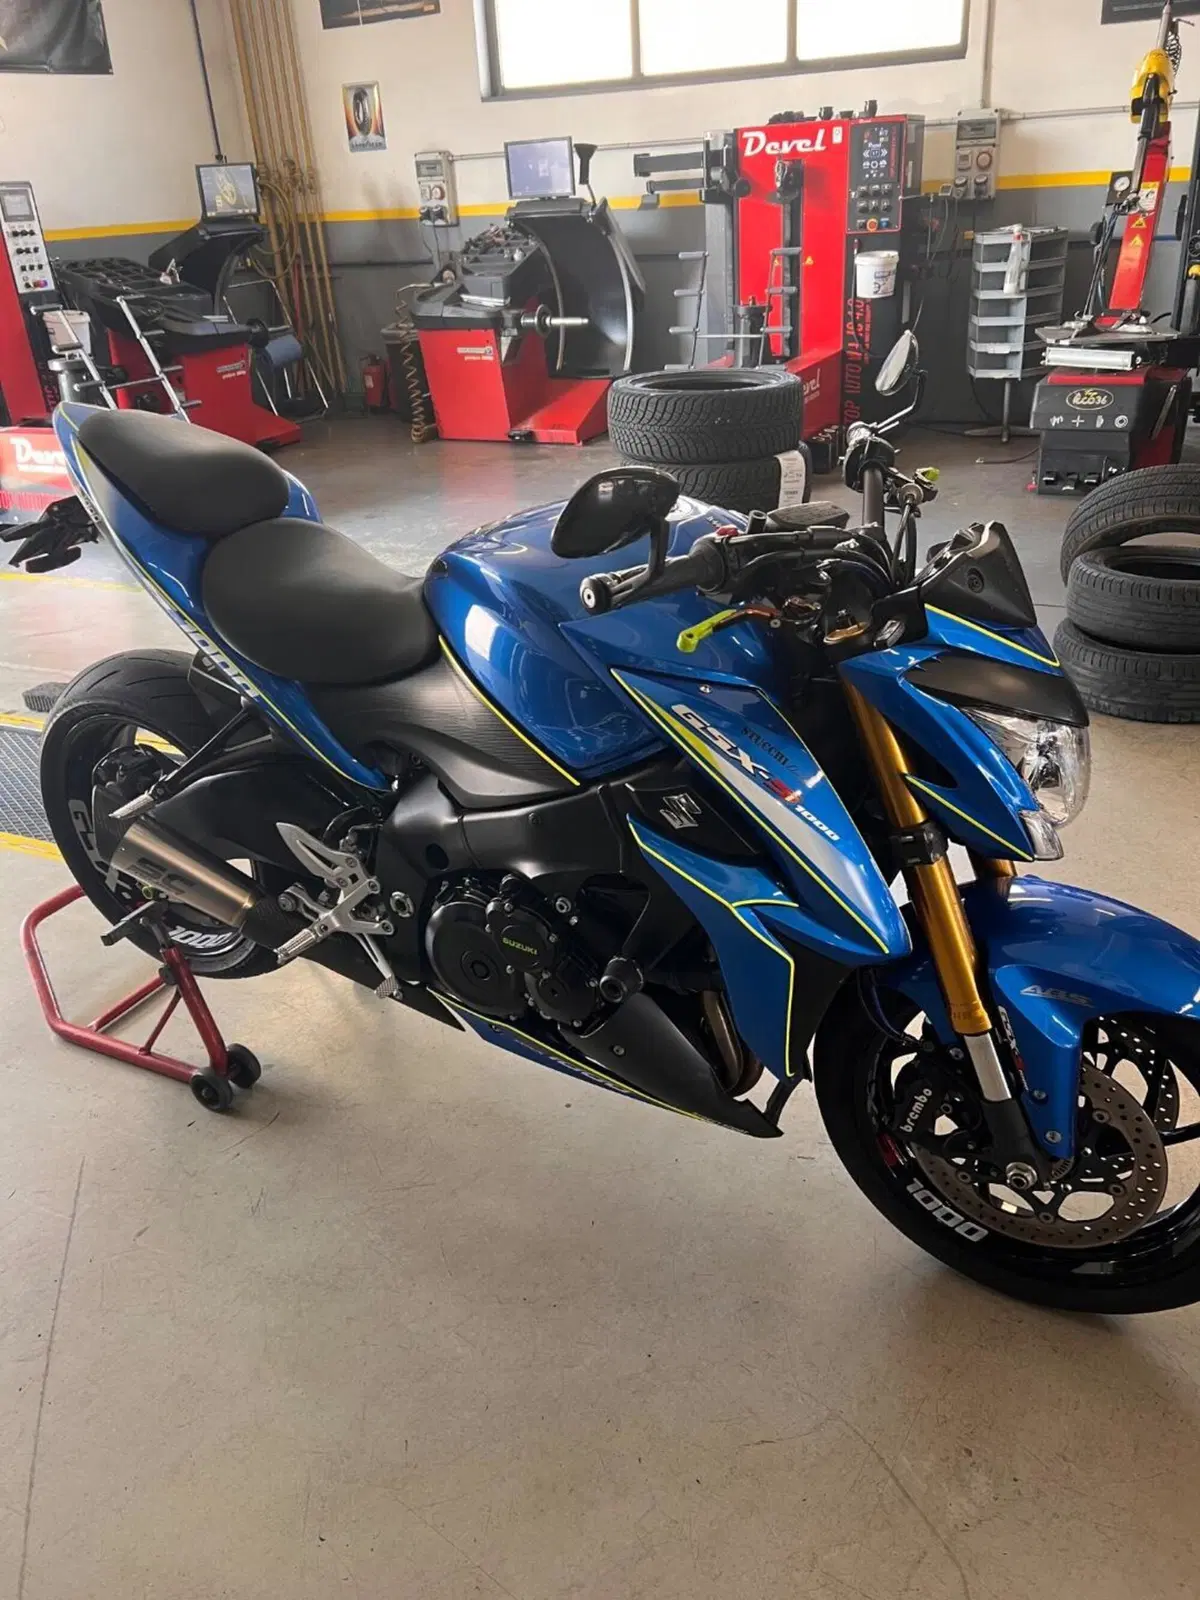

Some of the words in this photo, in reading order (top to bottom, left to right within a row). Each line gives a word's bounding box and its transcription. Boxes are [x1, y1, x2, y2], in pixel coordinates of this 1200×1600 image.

[742, 128, 827, 157] Devel
[168, 925, 234, 949] 1000
[502, 937, 538, 955] SUZUKI
[900, 1088, 933, 1133] brembo
[906, 1177, 989, 1243] 1000
